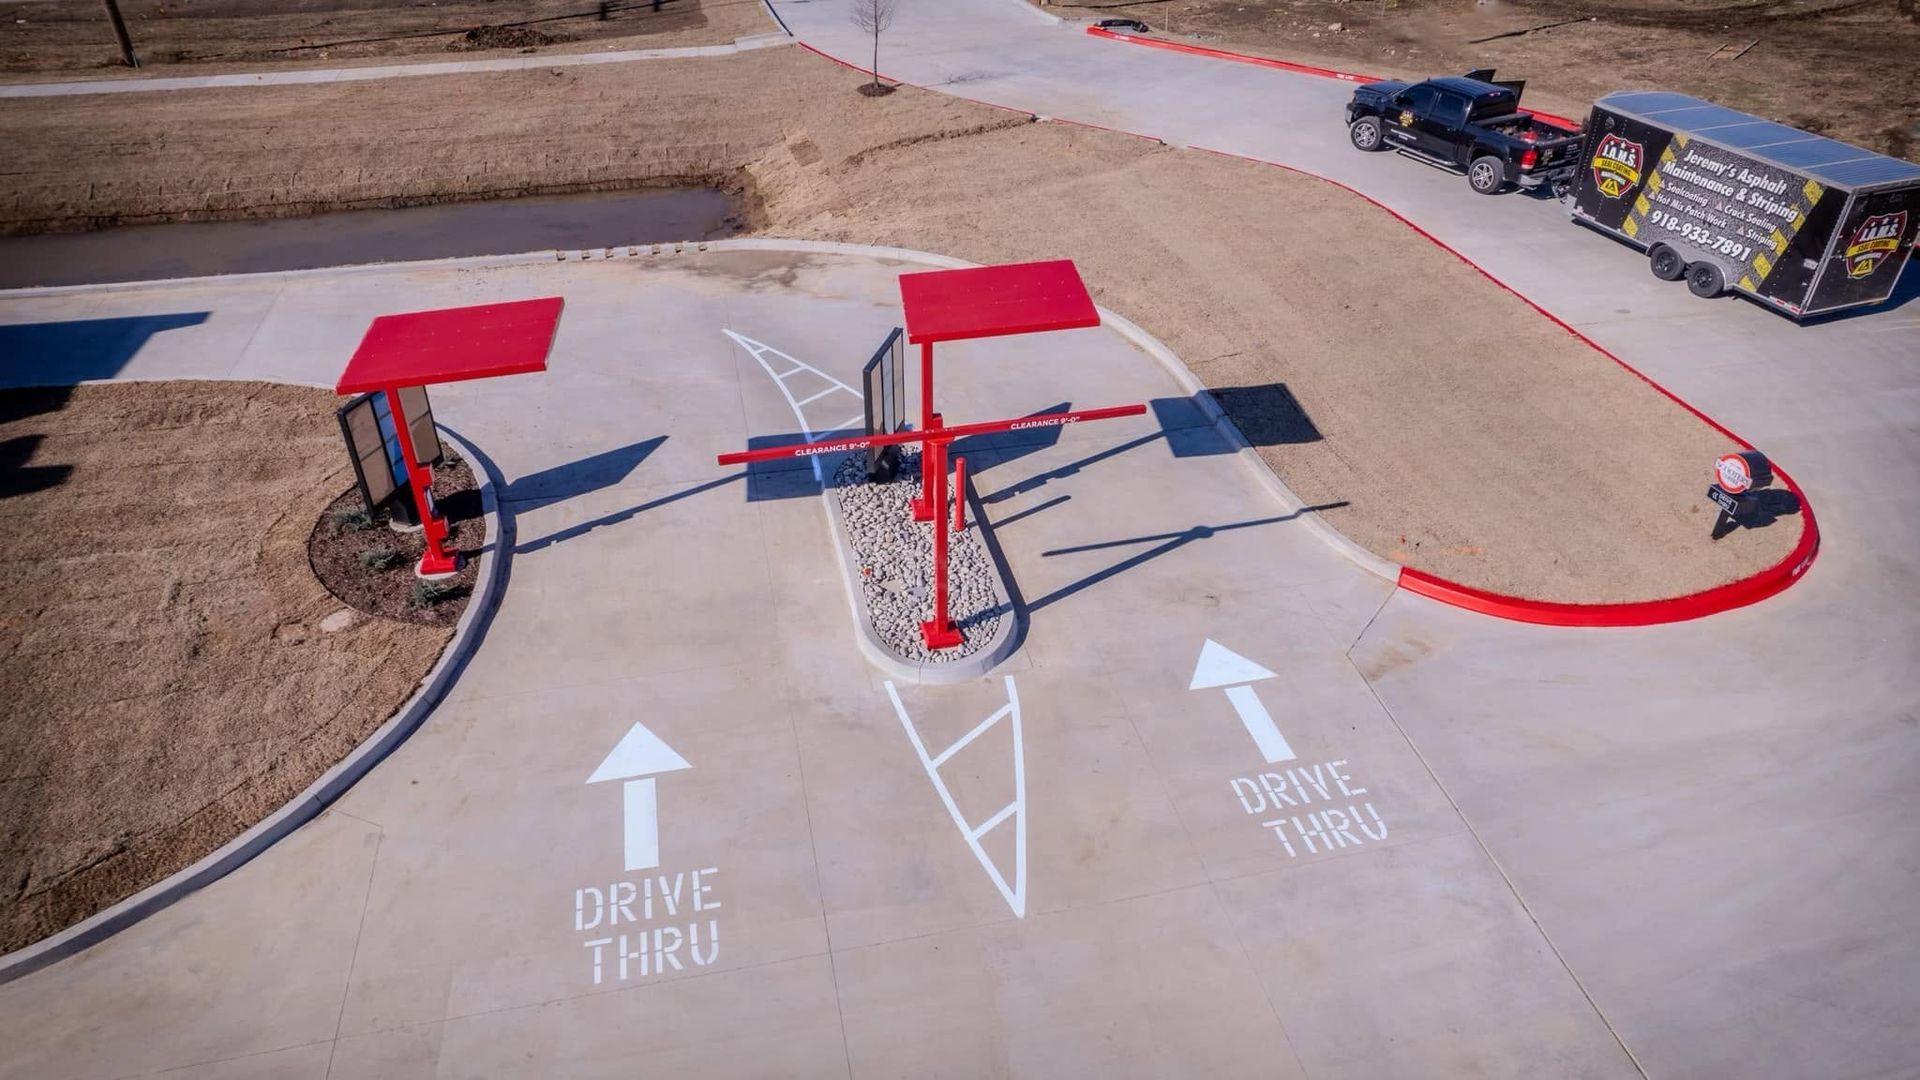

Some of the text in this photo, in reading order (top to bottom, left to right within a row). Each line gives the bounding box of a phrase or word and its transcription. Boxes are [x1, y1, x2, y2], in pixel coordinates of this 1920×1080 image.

[1602, 144, 1636, 168] J.A.M.S.
[1683, 150, 1788, 195] Jeremy's Asphalt
[1656, 193, 1728, 229] Hot Mix Patch Work
[1662, 161, 1734, 197] Maintenance
[1735, 188, 1748, 202] &
[1748, 192, 1799, 223] Striping
[1666, 182, 1709, 207] Sealcoating
[1650, 210, 1752, 261] 918-933-7891
[1724, 205, 1777, 233] Crack Sealing
[1746, 229, 1778, 250] Striping
[1010, 418, 1060, 430] CLEARANCE
[794, 444, 848, 457] CLEARANCE
[1230, 759, 1368, 815] DRIVE
[1262, 803, 1388, 857] THRU
[575, 867, 721, 931] DRIVE
[584, 919, 719, 985] THRU
